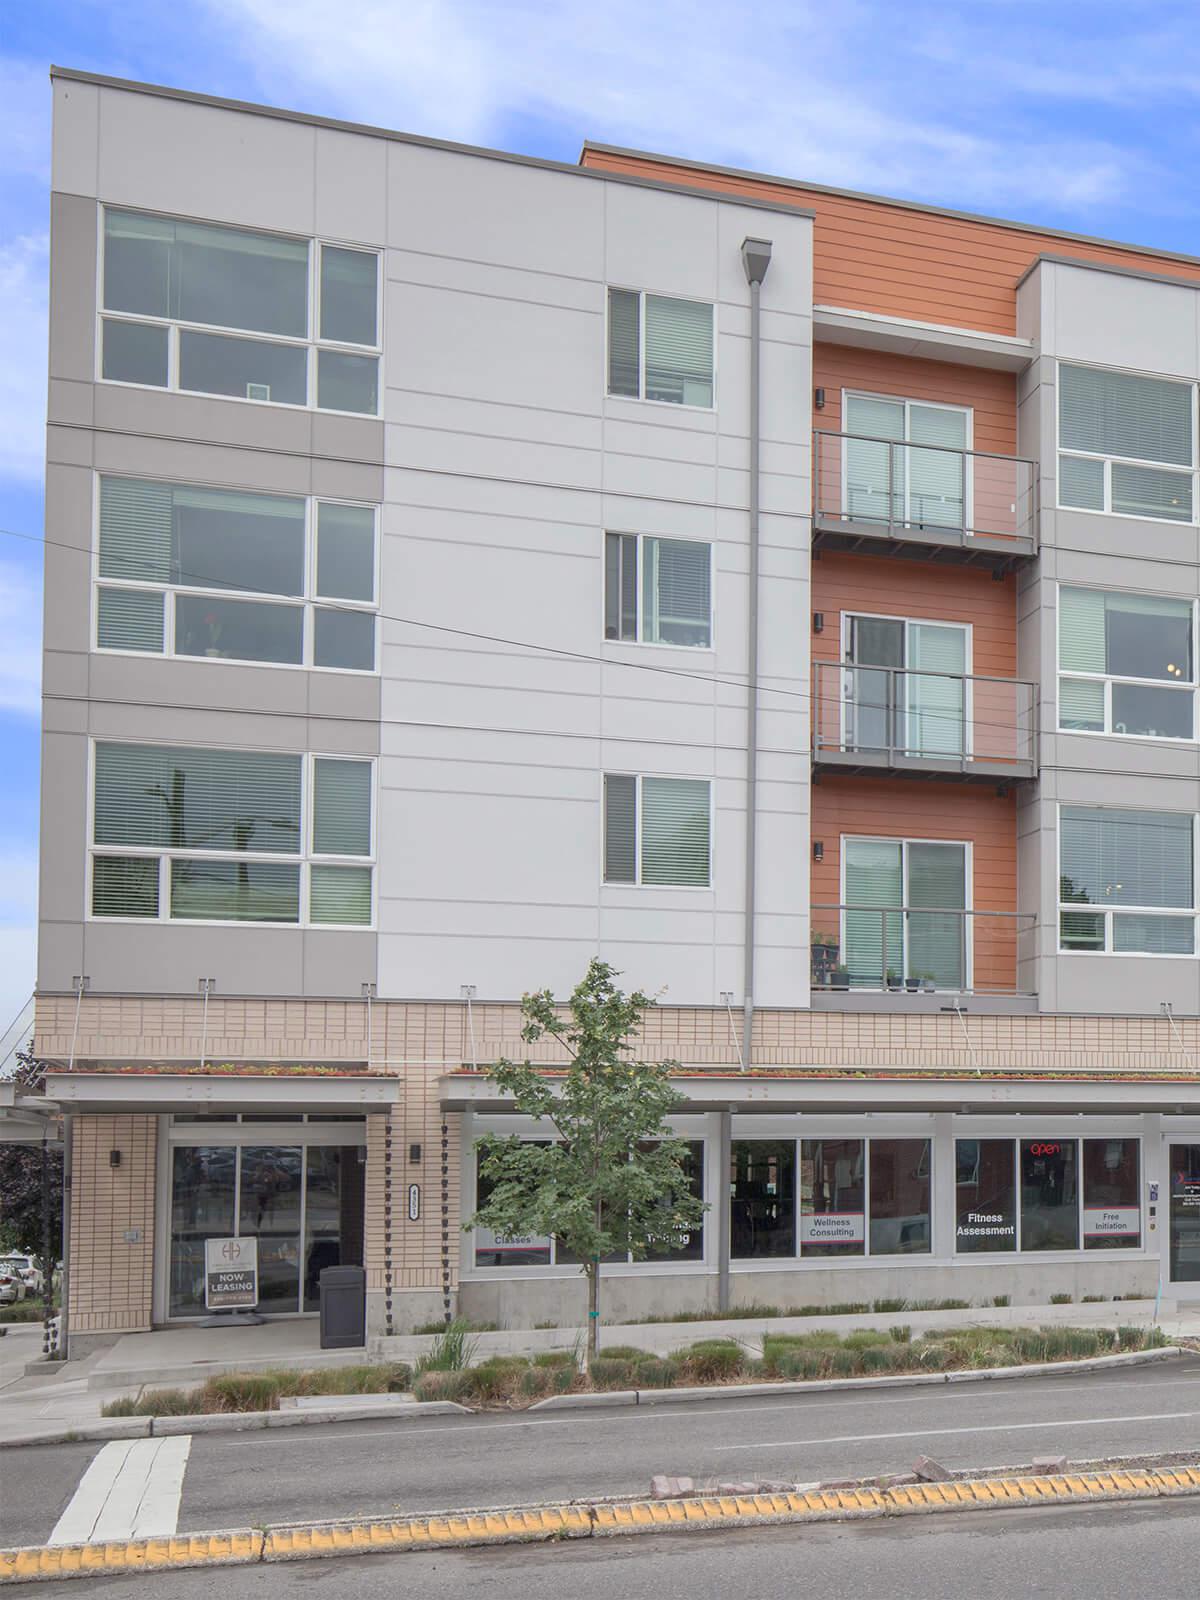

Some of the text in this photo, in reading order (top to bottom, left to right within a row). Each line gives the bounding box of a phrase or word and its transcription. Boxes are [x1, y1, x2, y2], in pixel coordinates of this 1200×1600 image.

[967, 1213, 1003, 1223] Fitness
[1103, 1212, 1120, 1221] Free
[813, 1218, 851, 1227] Wellness
[1095, 1222, 1128, 1231] Initiation
[809, 1228, 855, 1238] Consulting
[956, 1225, 1015, 1236] Assessment
[495, 1235, 531, 1245] Classes
[219, 1273, 245, 1282] NOW
[211, 1282, 253, 1293] LEASING
